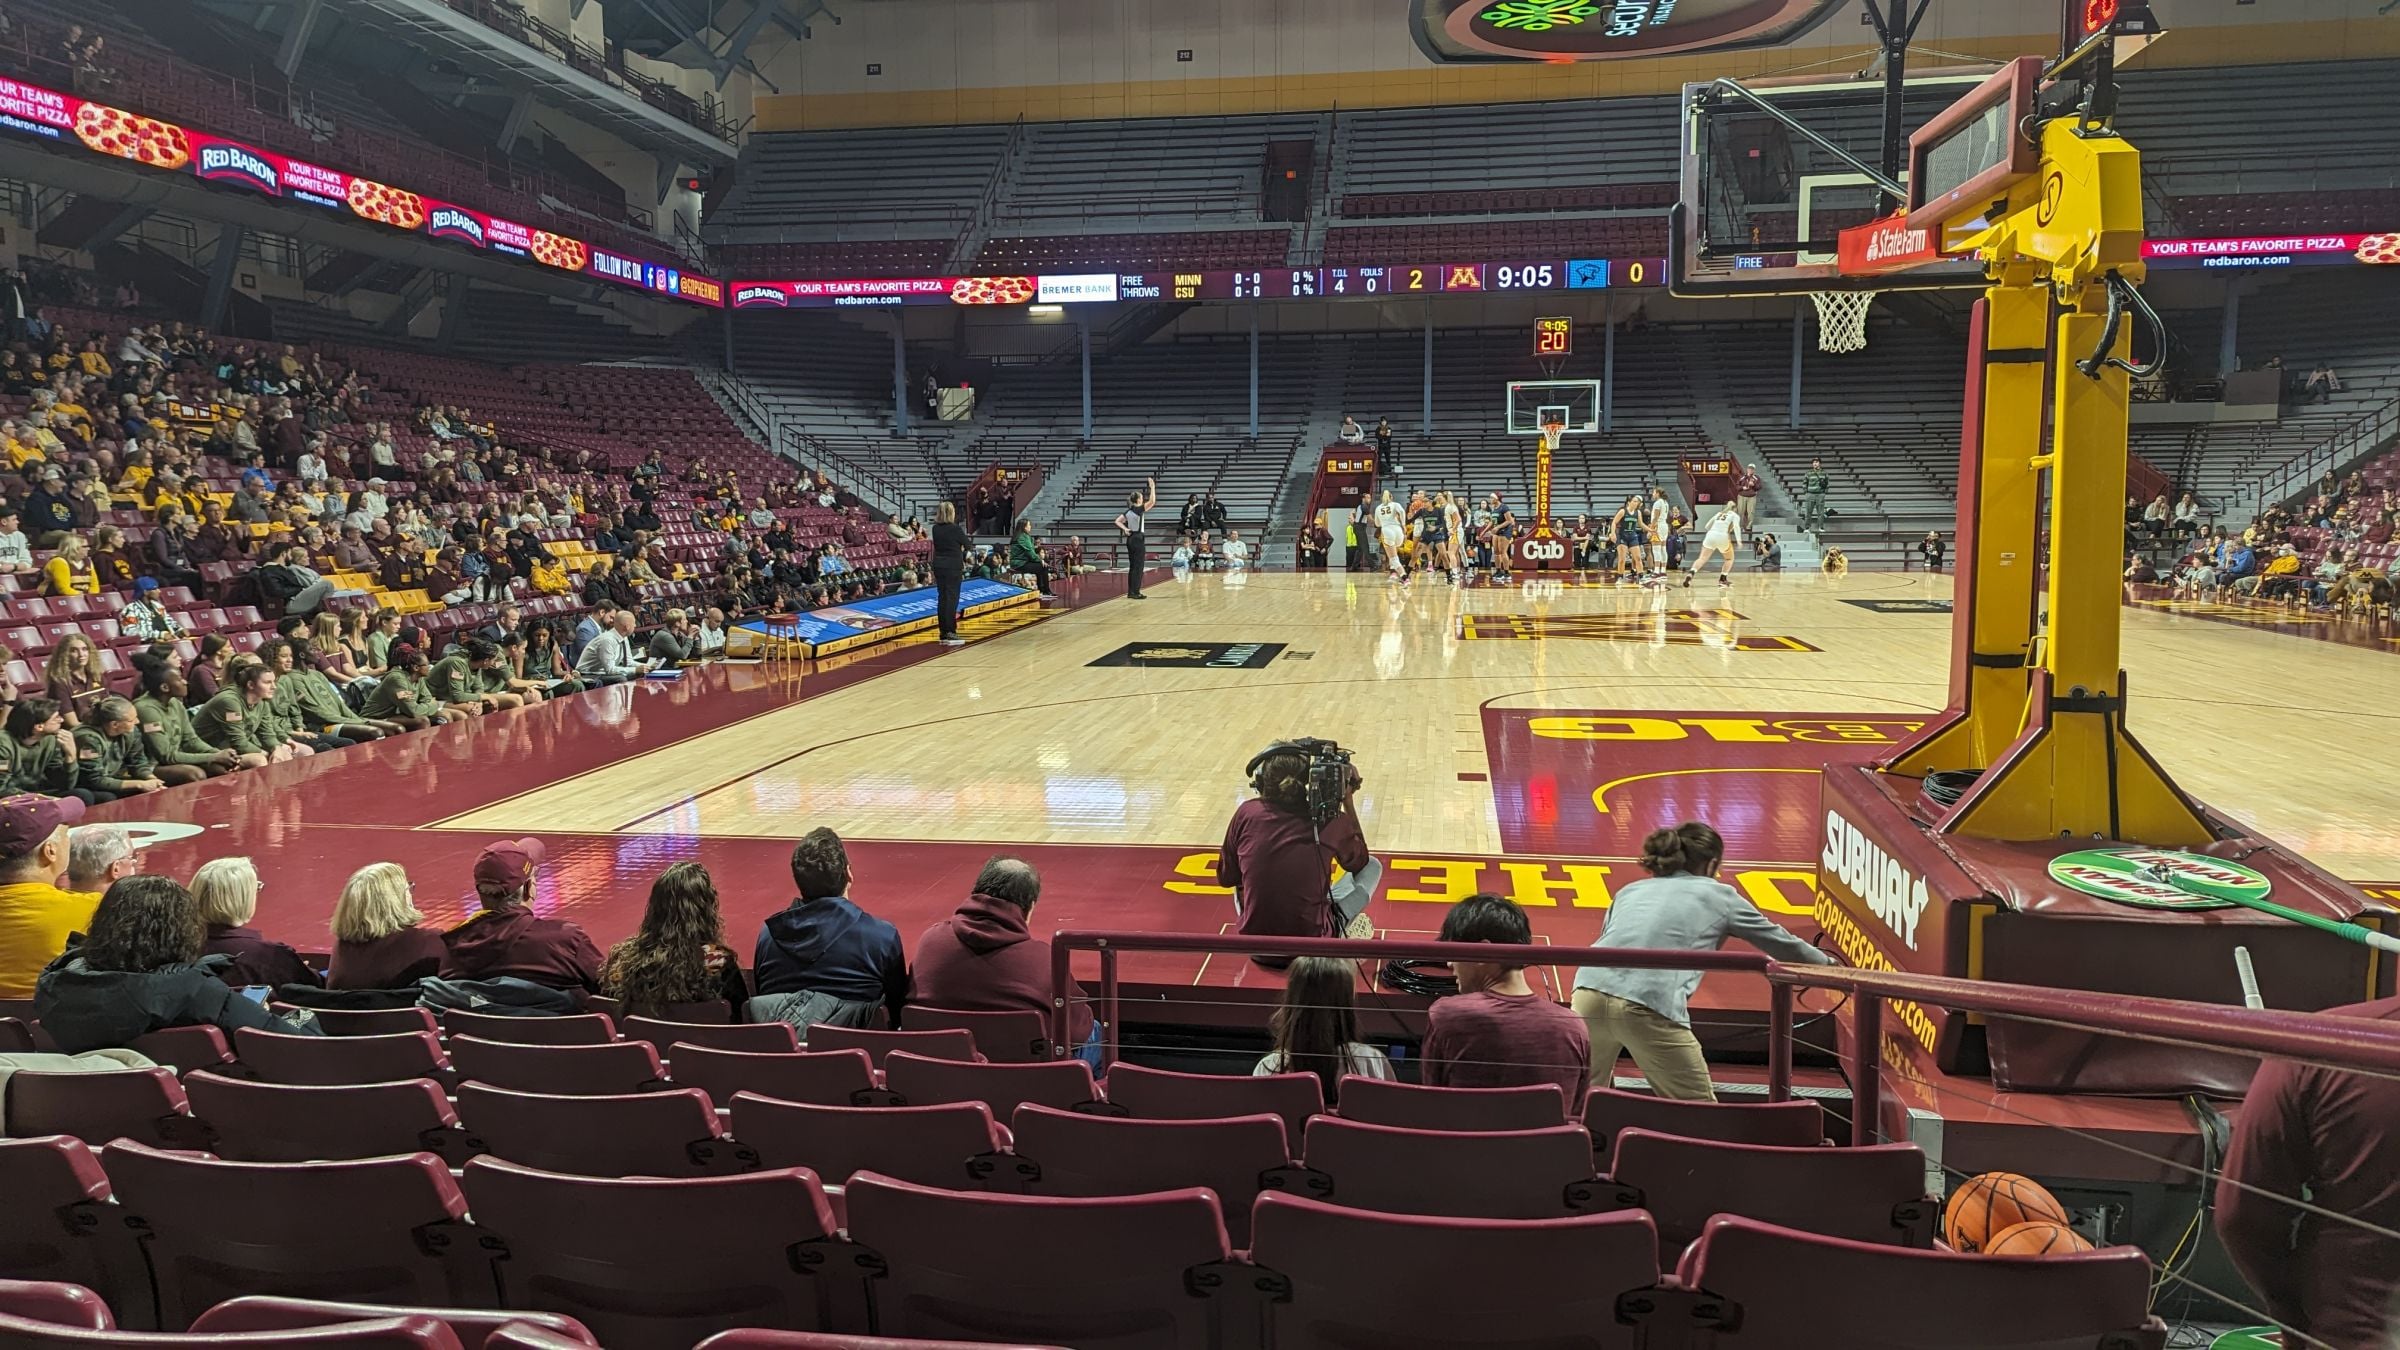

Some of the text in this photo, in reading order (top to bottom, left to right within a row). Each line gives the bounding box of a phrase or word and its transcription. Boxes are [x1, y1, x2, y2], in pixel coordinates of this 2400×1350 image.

[19, 85, 64, 109] TEAM'S
[37, 105, 73, 126] PIZZA
[202, 148, 276, 187] RED BARON
[288, 160, 341, 185] YOUR TEAM'S
[284, 172, 347, 198] FAVORITE PIZZA
[294, 190, 338, 207] redbaron.com
[432, 210, 482, 240] RED BARON
[490, 218, 527, 237] YOUR TEAM'S
[488, 228, 531, 248] FAVORITE PIZZA
[2152, 238, 2345, 254] YOUR TEAM'S FAVORITE PIZZA
[594, 251, 642, 282] FOLLOW US ON
[1738, 257, 1763, 268] FREE
[2203, 255, 2290, 267] redbaron.com
[1122, 275, 1143, 286] FREE
[1175, 274, 1201, 286] MINN
[1235, 273, 1242, 284] 0
[1253, 272, 1260, 284] 0
[1293, 271, 1300, 283] 0
[1303, 271, 1313, 283] %
[1360, 267, 1383, 277] FOULS
[1409, 270, 1423, 289] 2
[1498, 266, 1553, 288] 9:05
[1630, 263, 1644, 282] 0
[738, 287, 785, 301] RED BARON
[794, 281, 943, 294] YOUR TEAM'S FAVORITE PIZZA
[1042, 284, 1112, 294] BREMER BANK
[1122, 287, 1160, 298] THROWS
[1175, 287, 1195, 298] CSU
[1235, 286, 1242, 297] 0
[1253, 285, 1260, 297] 0
[1293, 284, 1300, 296] 0
[1303, 284, 1314, 295] %
[1335, 279, 1376, 293] 4 0
[835, 295, 902, 305] redbaron.com
[1544, 321, 1568, 331] 9:05
[1541, 332, 1565, 350] 20
[1540, 457, 1548, 526] MINNESOTA
[1380, 507, 1392, 516] 52
[1522, 540, 1565, 560] Cub
[1822, 809, 1929, 951] SUBWAY
